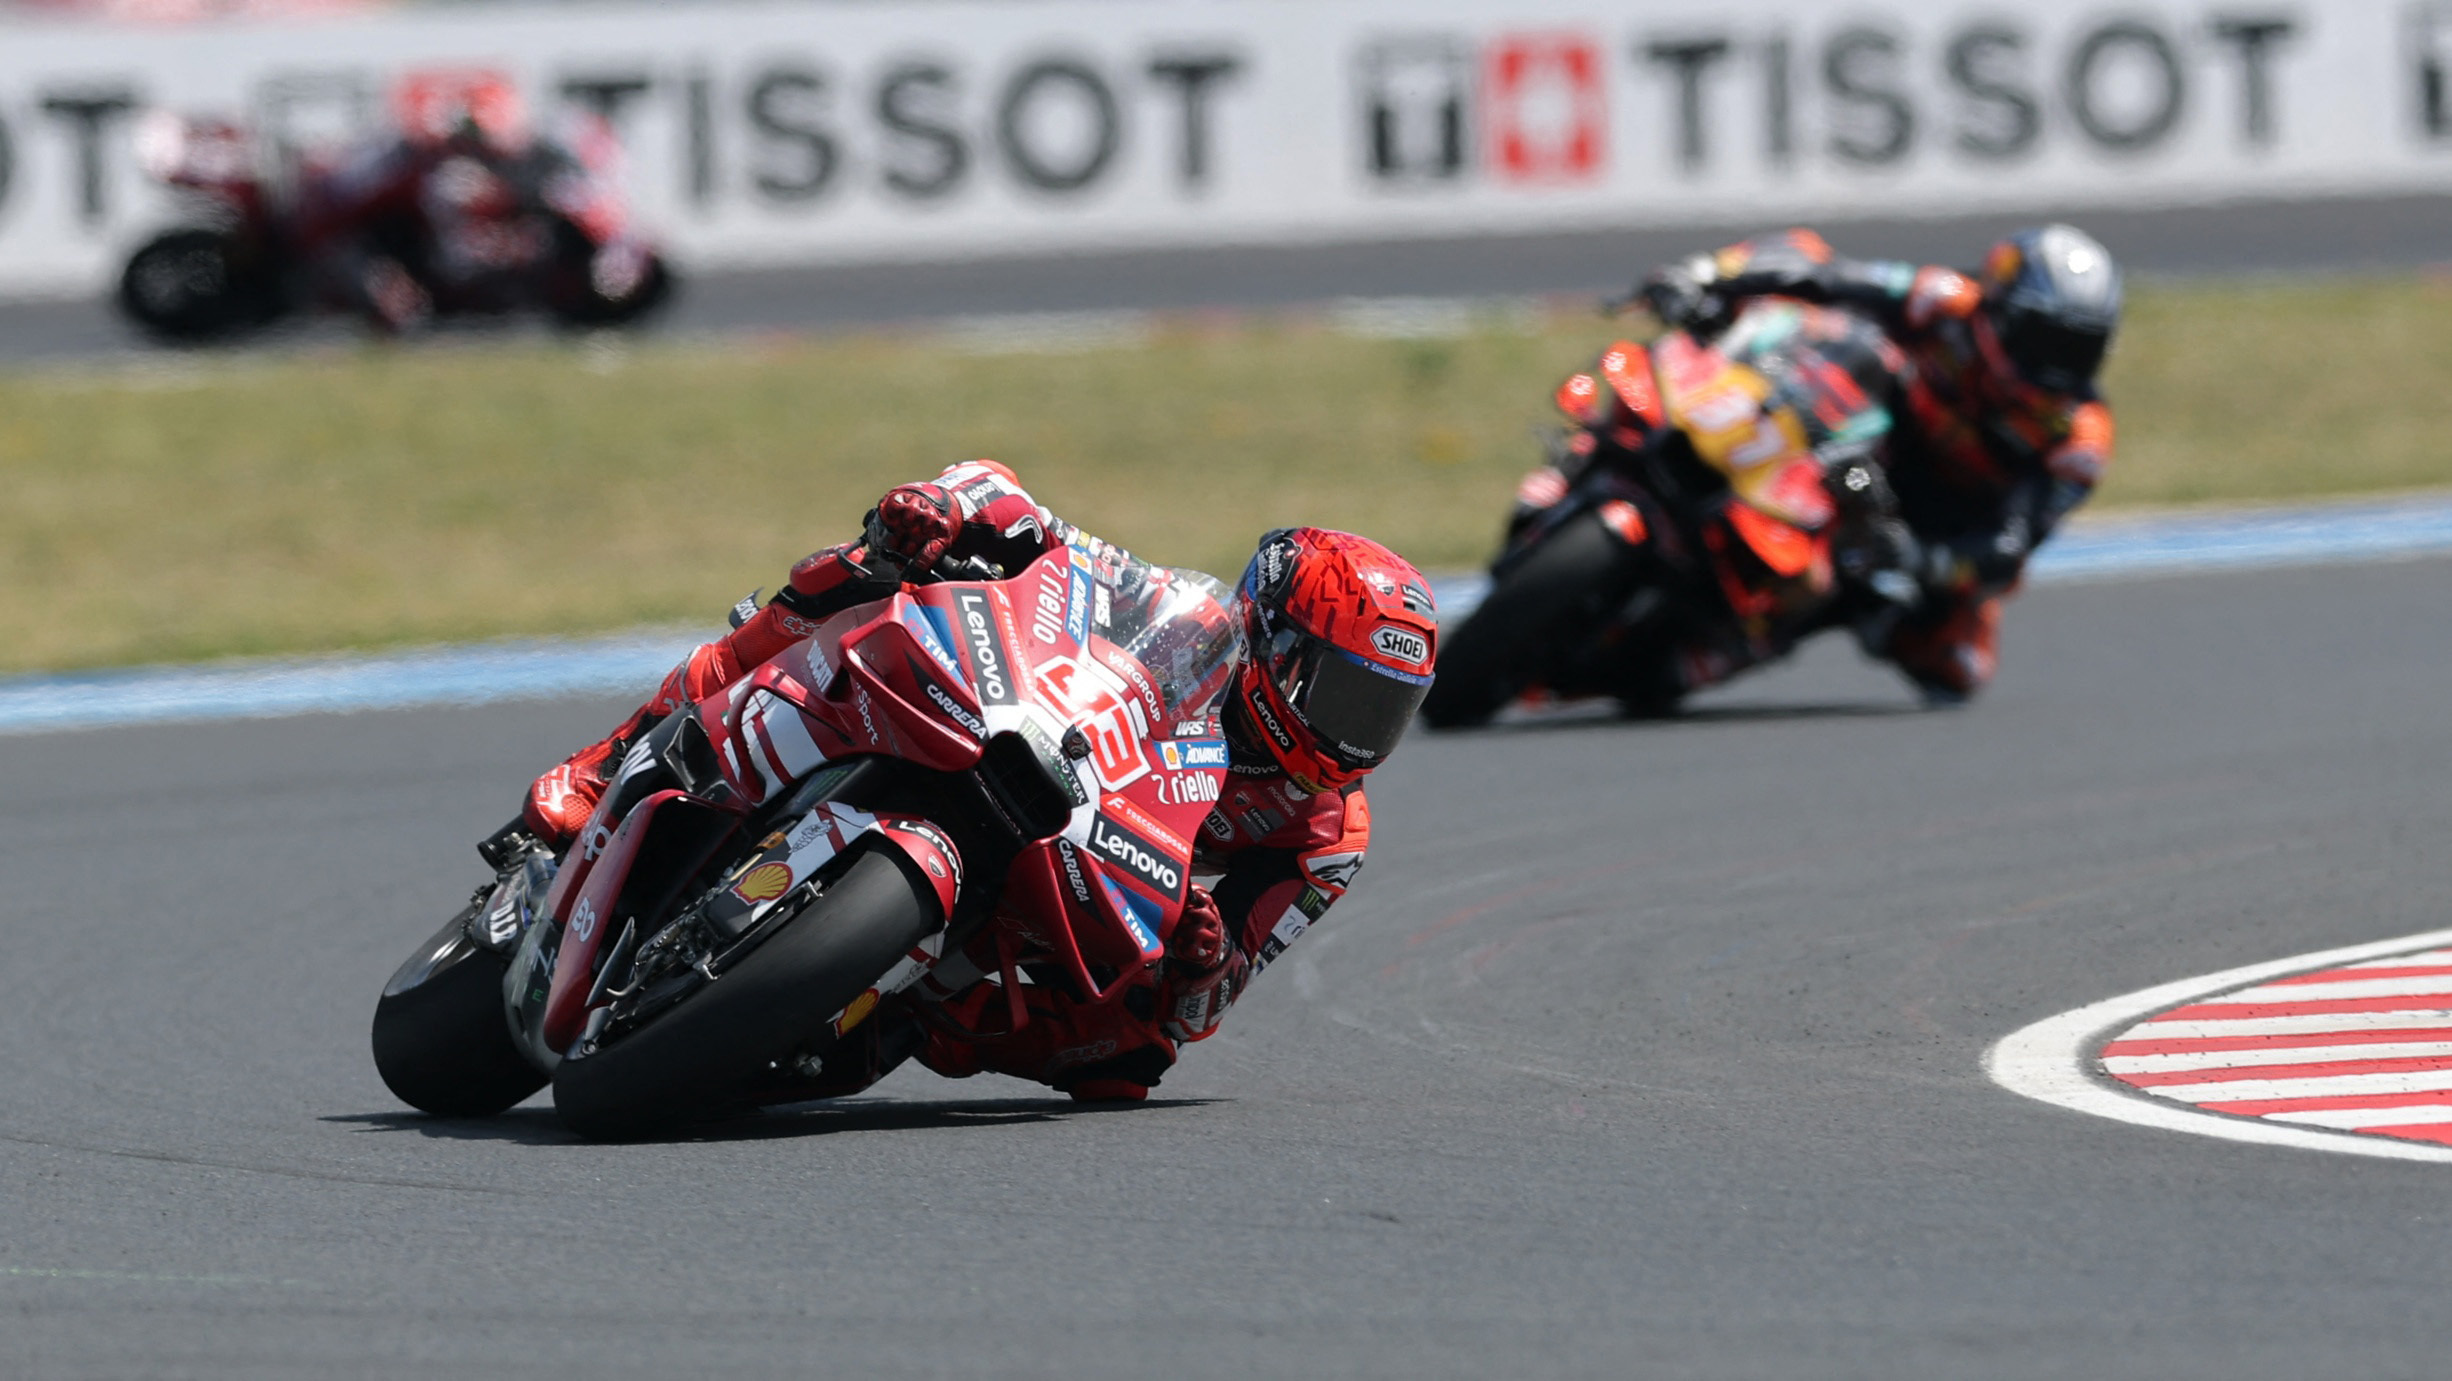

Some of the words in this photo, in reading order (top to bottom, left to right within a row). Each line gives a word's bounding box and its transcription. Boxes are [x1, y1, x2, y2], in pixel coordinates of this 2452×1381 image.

[1638, 17, 2296, 174] TISSOT
[552, 52, 1238, 202] TISSOT
[1032, 572, 1067, 645] riello
[924, 635, 958, 672] TIM
[961, 595, 1006, 700] Lenovo
[1381, 631, 1424, 660] SHOEI
[926, 684, 987, 740] CARRERA
[1108, 650, 1161, 723] VARGROUP
[857, 689, 879, 746] Sport
[1034, 659, 1148, 788] 93
[1175, 720, 1205, 737] WRS
[1252, 691, 1289, 747] Lenovo
[1038, 735, 1086, 805] MONSTER
[1185, 743, 1226, 764] ADVANCE
[1338, 741, 1375, 759] Insta360
[1171, 771, 1220, 804] riello
[1267, 786, 1296, 817] motorola
[1126, 808, 1189, 855] FRECCIAROSSA
[1206, 811, 1231, 837] OEI
[1058, 839, 1090, 902] CARRERA
[1094, 820, 1178, 889] Lenovo
[1124, 908, 1149, 949] TIM
